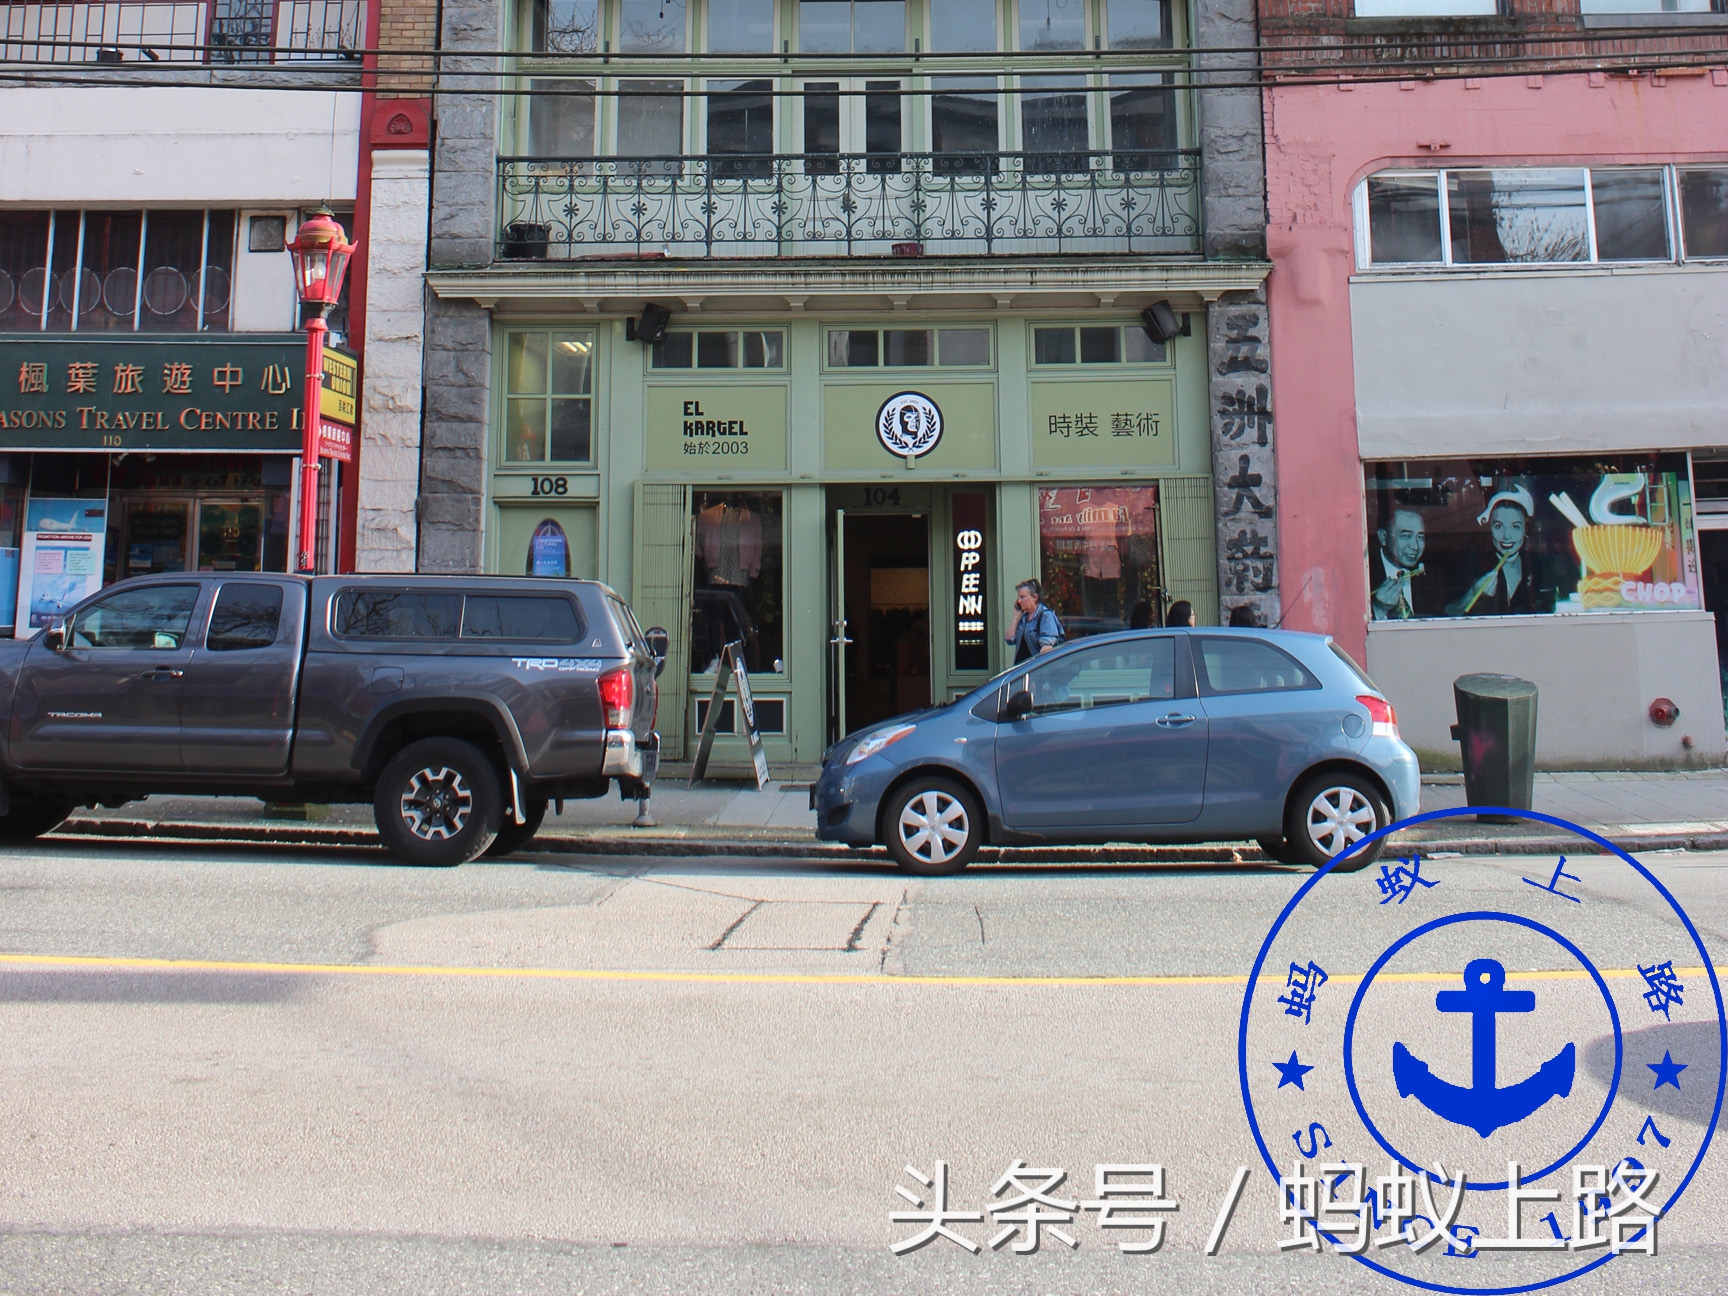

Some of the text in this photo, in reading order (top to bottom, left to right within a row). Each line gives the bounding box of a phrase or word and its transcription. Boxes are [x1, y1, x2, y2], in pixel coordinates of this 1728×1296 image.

[18, 362, 292, 395] 楓葉旅遊中心
[323, 356, 351, 382] WESTERN
[331, 376, 352, 396] UNION
[76, 406, 169, 430] TRAVEL
[179, 407, 279, 430] CENTRE
[684, 401, 704, 416] EL
[1049, 412, 1160, 438] 時裝 藝術
[102, 435, 122, 447] 110
[531, 476, 568, 495] 108
[864, 487, 901, 505] 104
[511, 657, 558, 670] TRD
